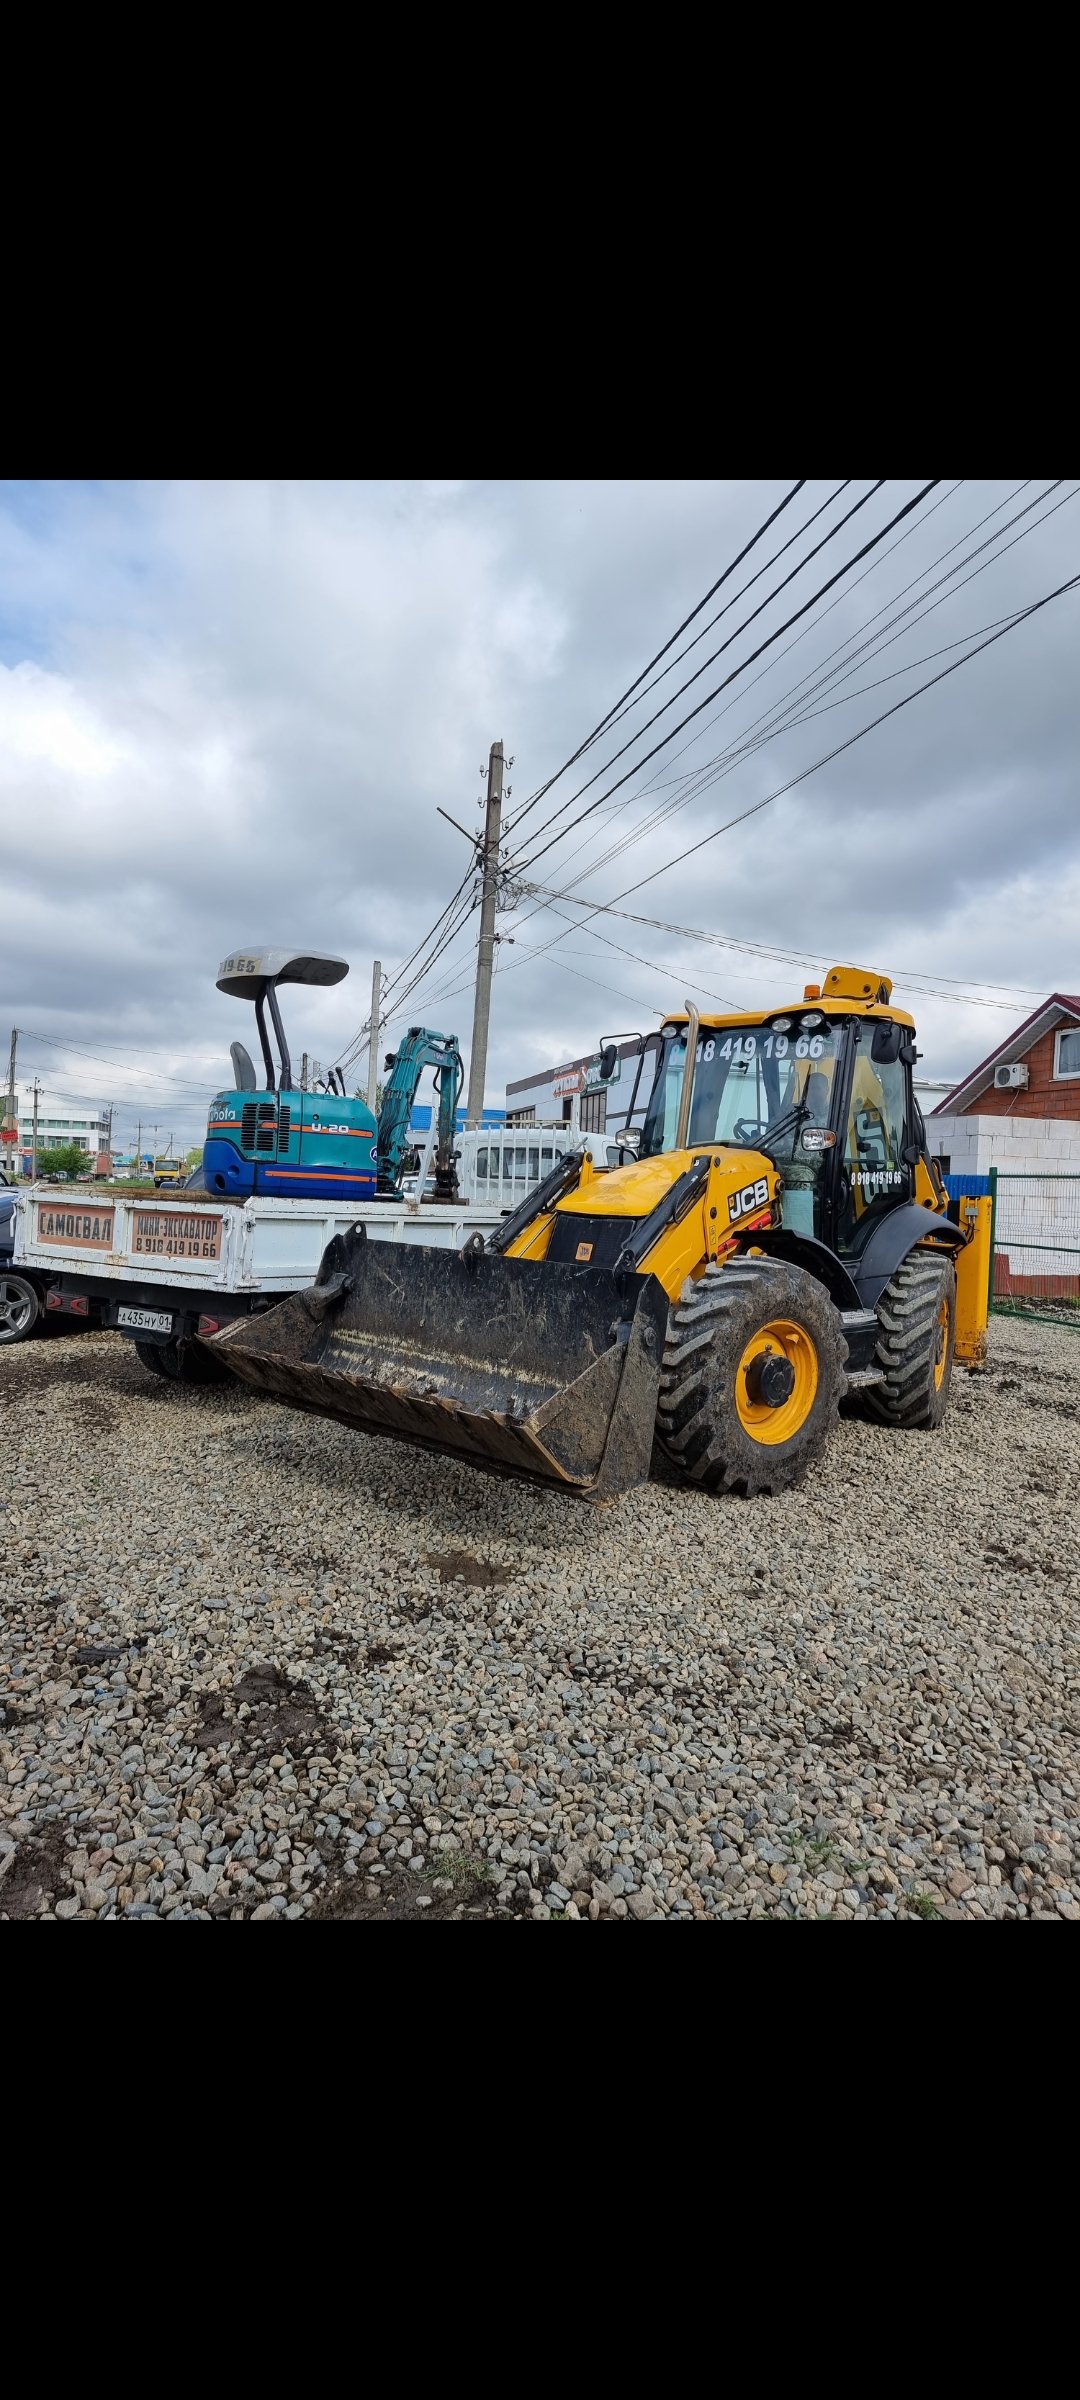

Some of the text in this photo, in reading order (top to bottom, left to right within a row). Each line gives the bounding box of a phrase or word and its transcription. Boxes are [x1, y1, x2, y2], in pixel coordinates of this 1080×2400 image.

[695, 1040, 715, 1063] 18
[719, 1036, 757, 1061] 419
[763, 1035, 789, 1059] 19
[795, 1034, 825, 1059] 66
[311, 1122, 349, 1134] U-20
[850, 1171, 902, 1186] 8 918 419 19 66
[729, 1179, 769, 1220] JCB
[39, 1211, 112, 1242] САМОСВАЛ
[137, 1215, 218, 1241] МИНИ-ЭКСКАВАТОР
[136, 1237, 142, 1252] 8
[166, 1240, 185, 1255] 419
[187, 1242, 200, 1256] 19
[202, 1242, 216, 1258] 66
[159, 1315, 169, 1327] 01
